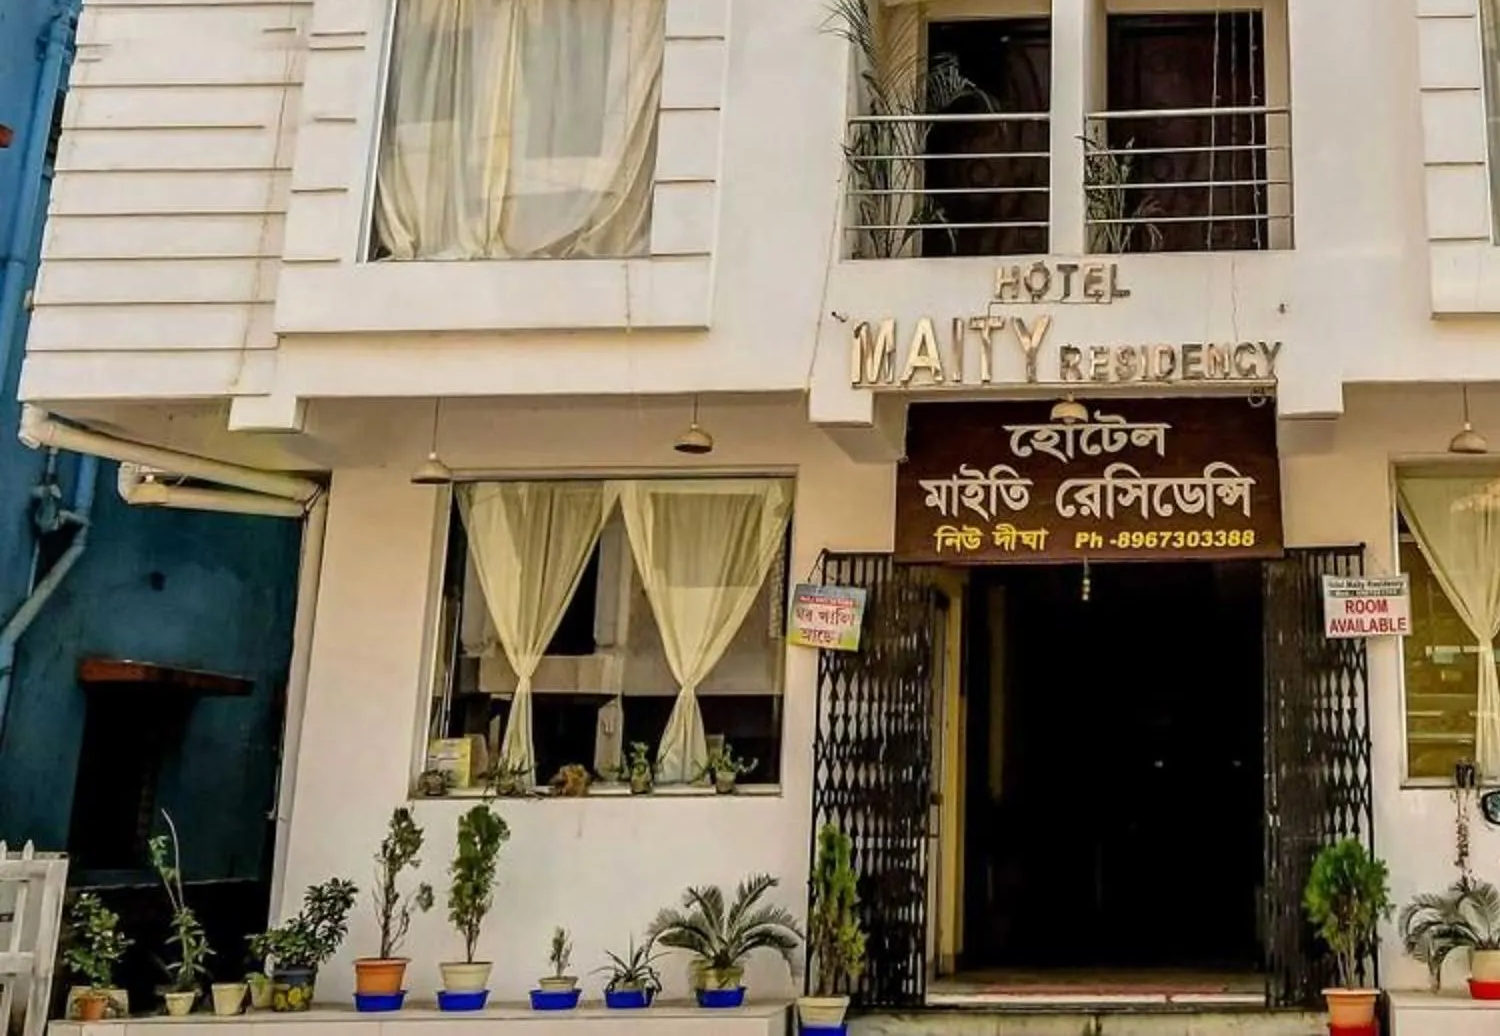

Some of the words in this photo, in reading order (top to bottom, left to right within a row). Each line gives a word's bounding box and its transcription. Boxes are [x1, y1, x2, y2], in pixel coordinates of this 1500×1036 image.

[994, 261, 1131, 301] HOTEL
[851, 315, 1052, 386] MAITY
[1058, 341, 1283, 381] RESIDENCY
[1002, 410, 1172, 463] হোটেল
[918, 463, 1034, 521] মাইতি
[1055, 461, 1257, 520] রেসিডেন্সি
[934, 525, 984, 553] নিউ
[991, 523, 1050, 552] দীঘা
[1075, 531, 1103, 549] Ph
[1345, 599, 1389, 614] ROOM
[1329, 617, 1408, 633] AVAILABLE
